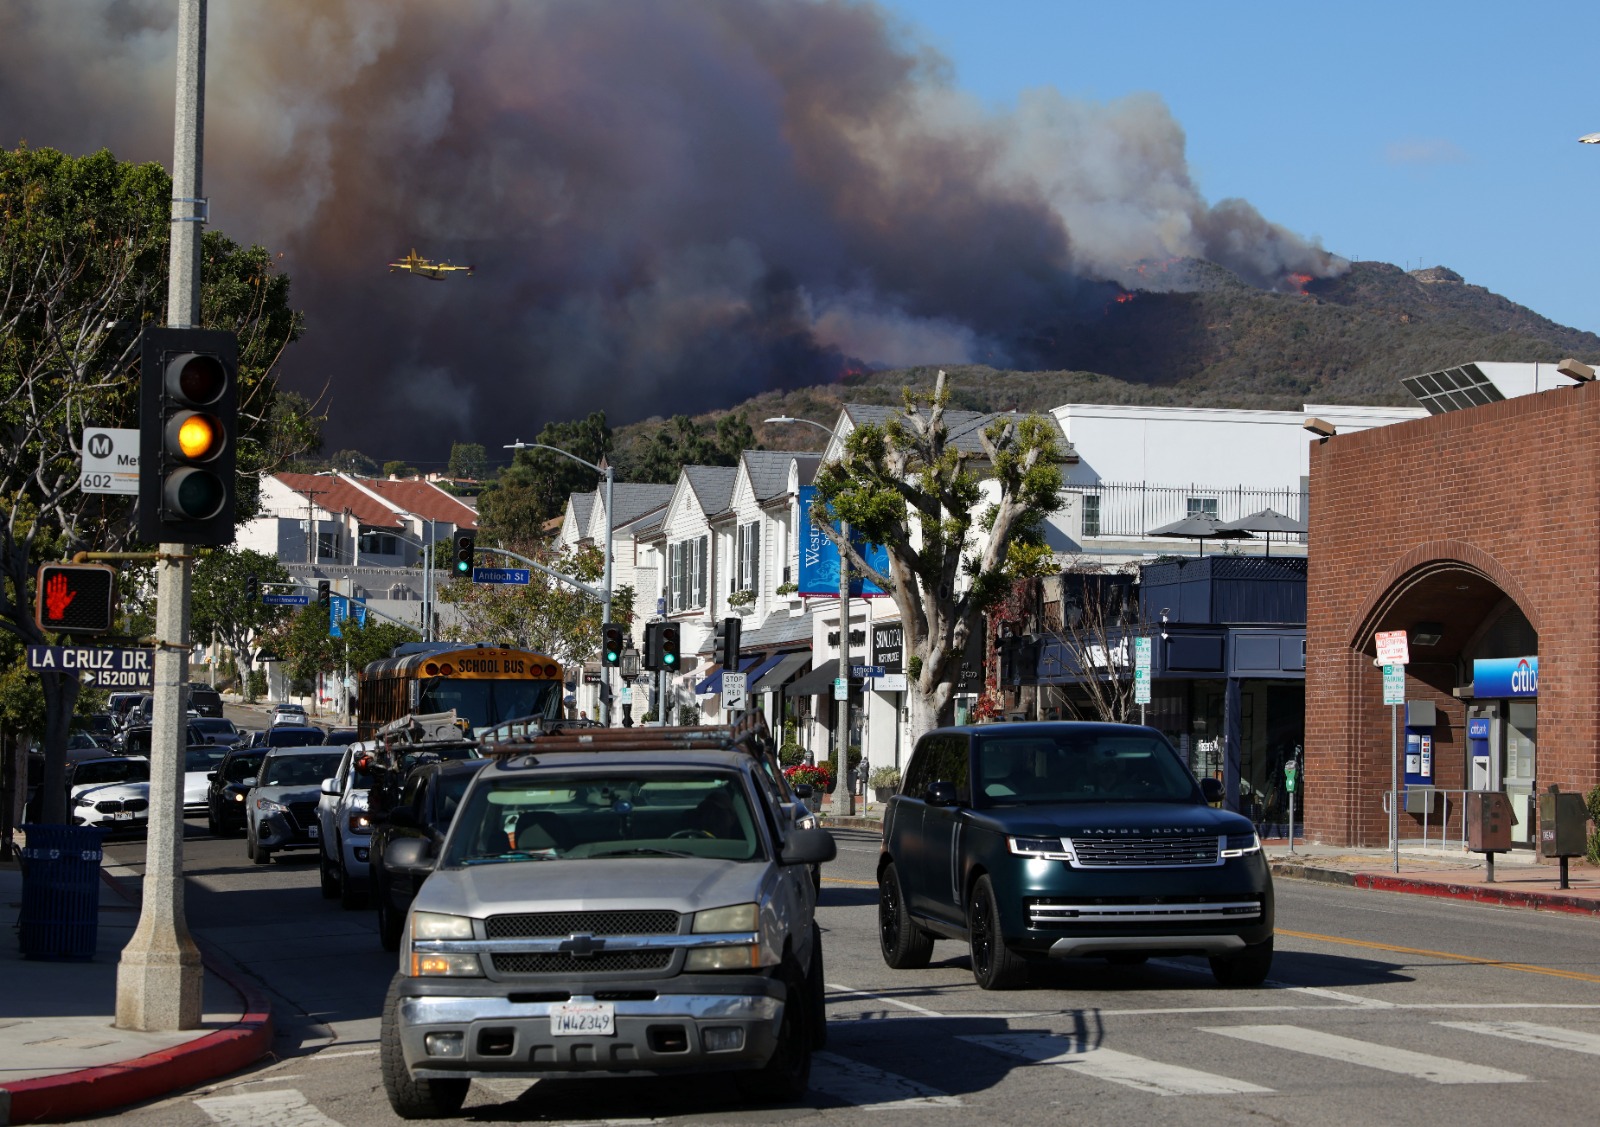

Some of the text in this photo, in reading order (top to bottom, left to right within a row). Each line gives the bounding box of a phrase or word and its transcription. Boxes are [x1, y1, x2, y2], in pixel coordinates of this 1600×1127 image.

[92, 437, 110, 455] M
[83, 474, 111, 488] 602
[478, 571, 524, 581] Antioch St
[1377, 640, 1386, 648] NO
[32, 649, 151, 670] LA CRUZ DR.
[459, 659, 524, 673] SCHOOL BUS
[98, 671, 150, 686] 15200 W.
[1512, 663, 1538, 692] citib
[556, 1015, 610, 1030] 7W42349
